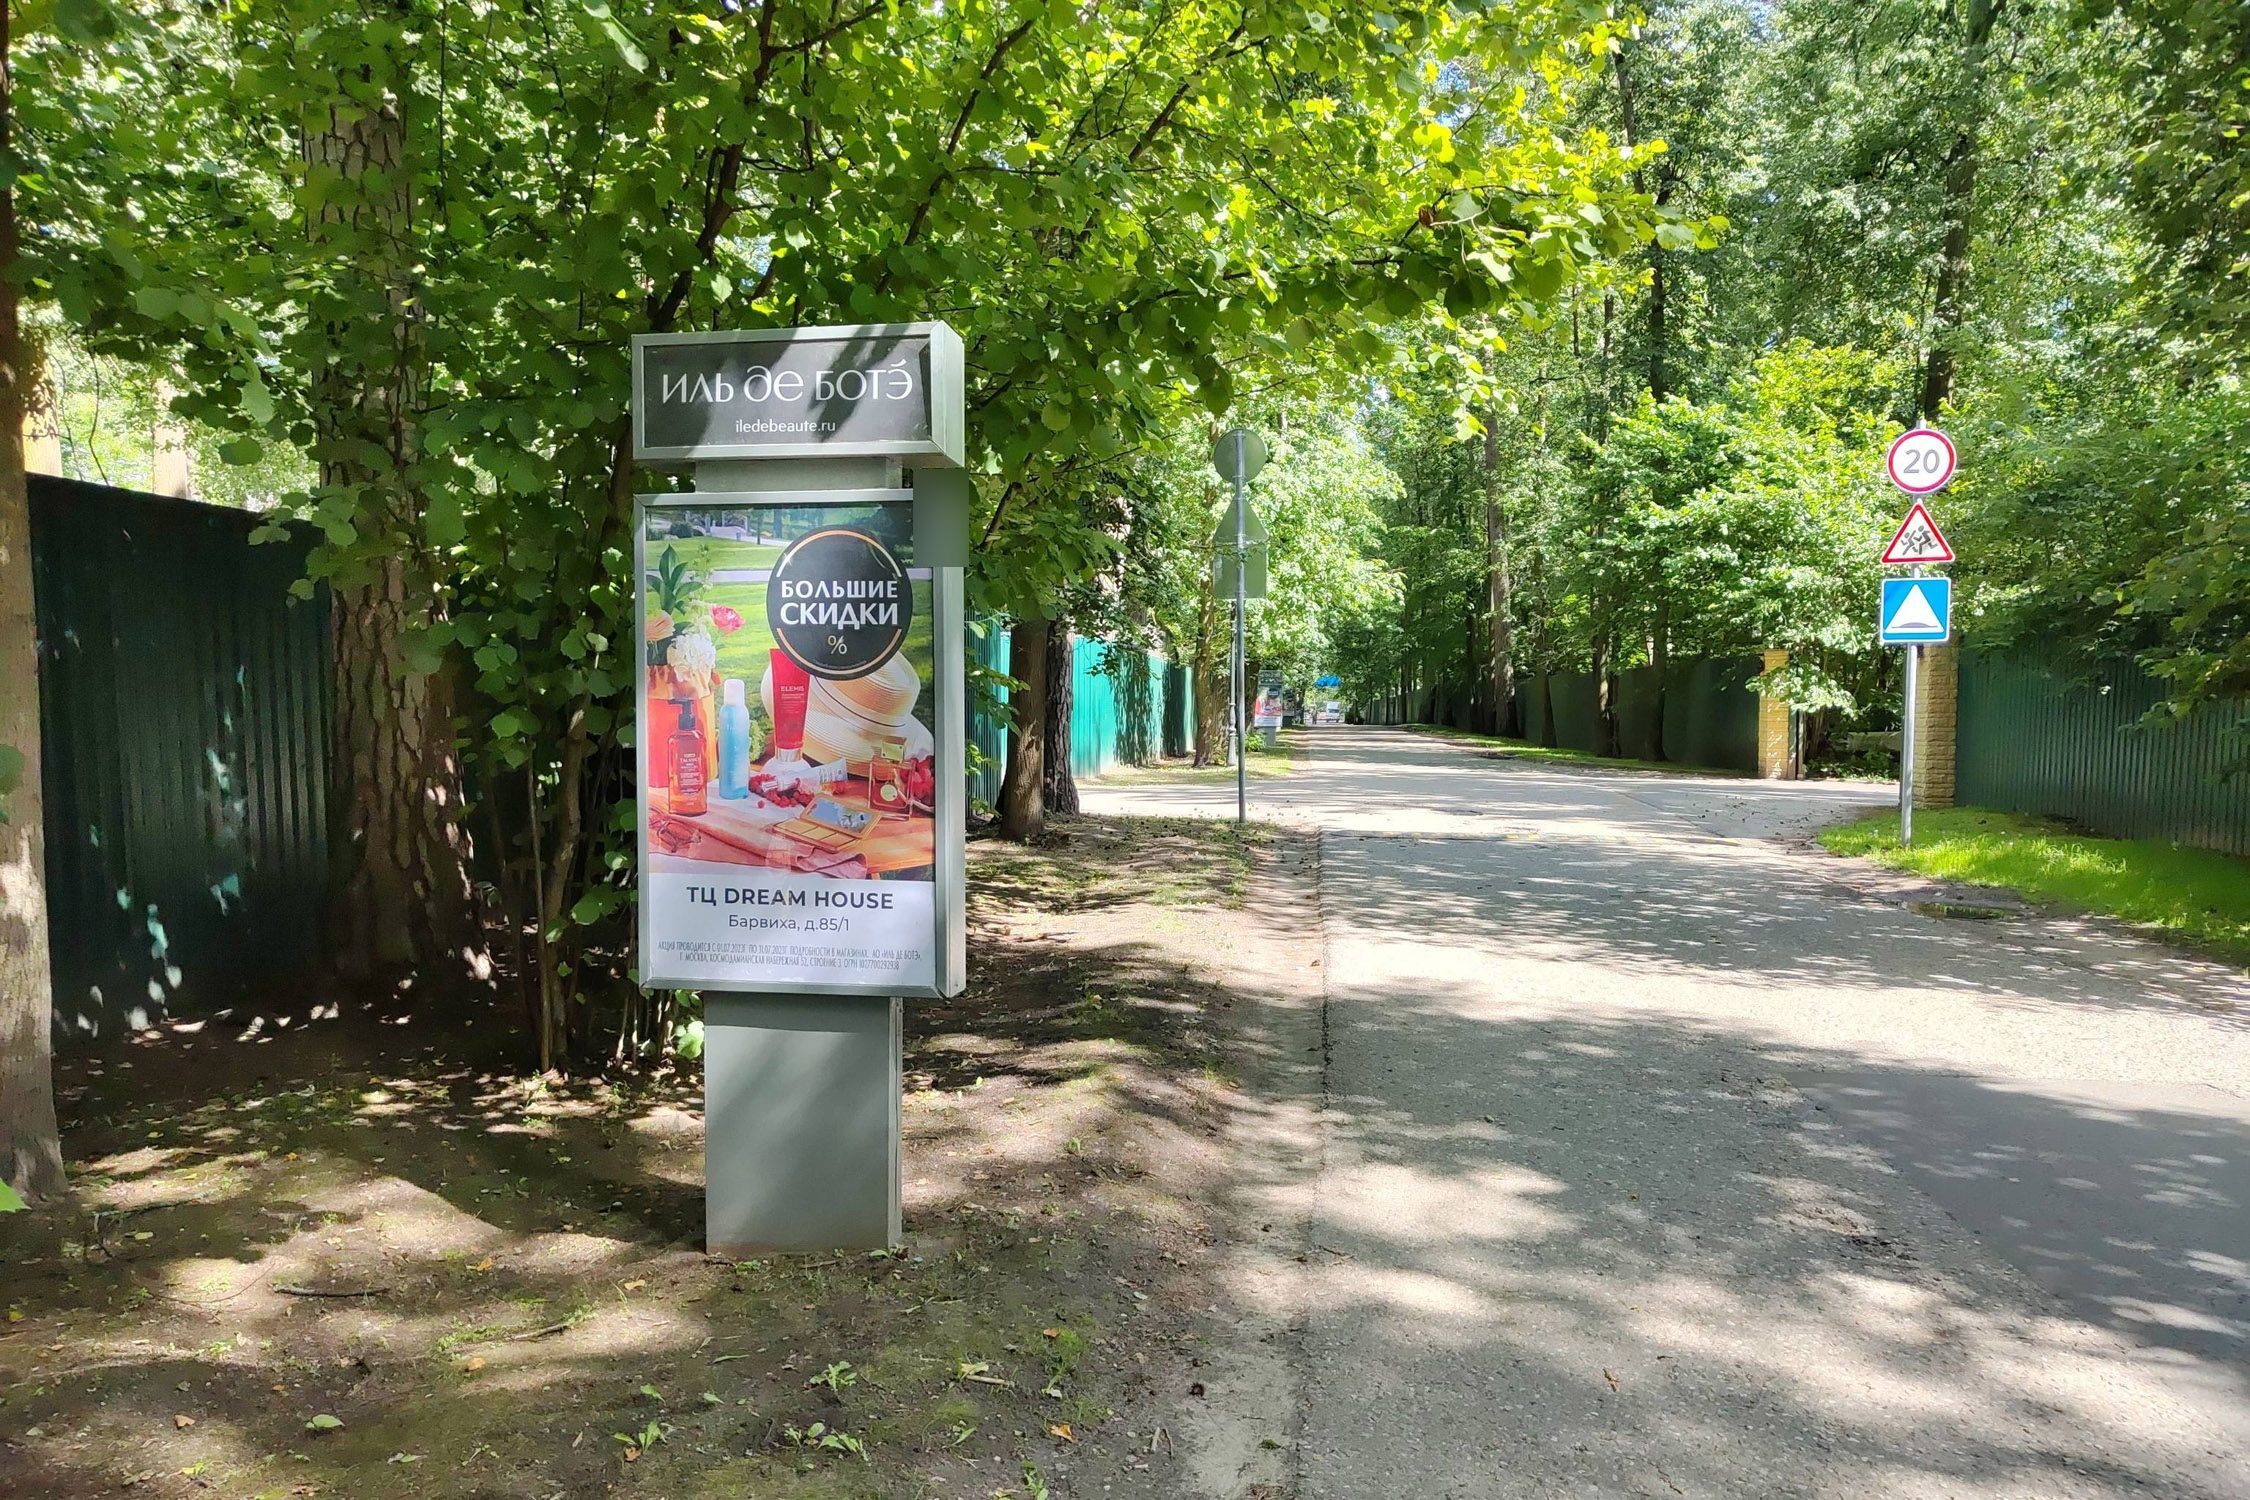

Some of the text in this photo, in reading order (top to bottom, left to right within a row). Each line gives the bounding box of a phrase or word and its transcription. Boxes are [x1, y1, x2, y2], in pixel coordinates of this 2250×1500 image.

[662, 373, 734, 403] ИЛЬ
[735, 419, 836, 433] iledebeaute.ru
[1903, 449, 1940, 473] 20
[781, 580, 898, 598] БОЛЬШИЕ
[780, 602, 898, 630] СКИДКИ
[827, 635, 848, 655] %
[686, 886, 894, 909] ТЦ DREAM HOUSE
[728, 914, 849, 932] Барвиха, д.85/1
[658, 941, 675, 952] АКЦИЯ
[676, 941, 711, 953] ПРОВОДИТСЯ
[749, 944, 757, 954] ПО
[789, 946, 830, 957] ПОДРОБНОСТИ
